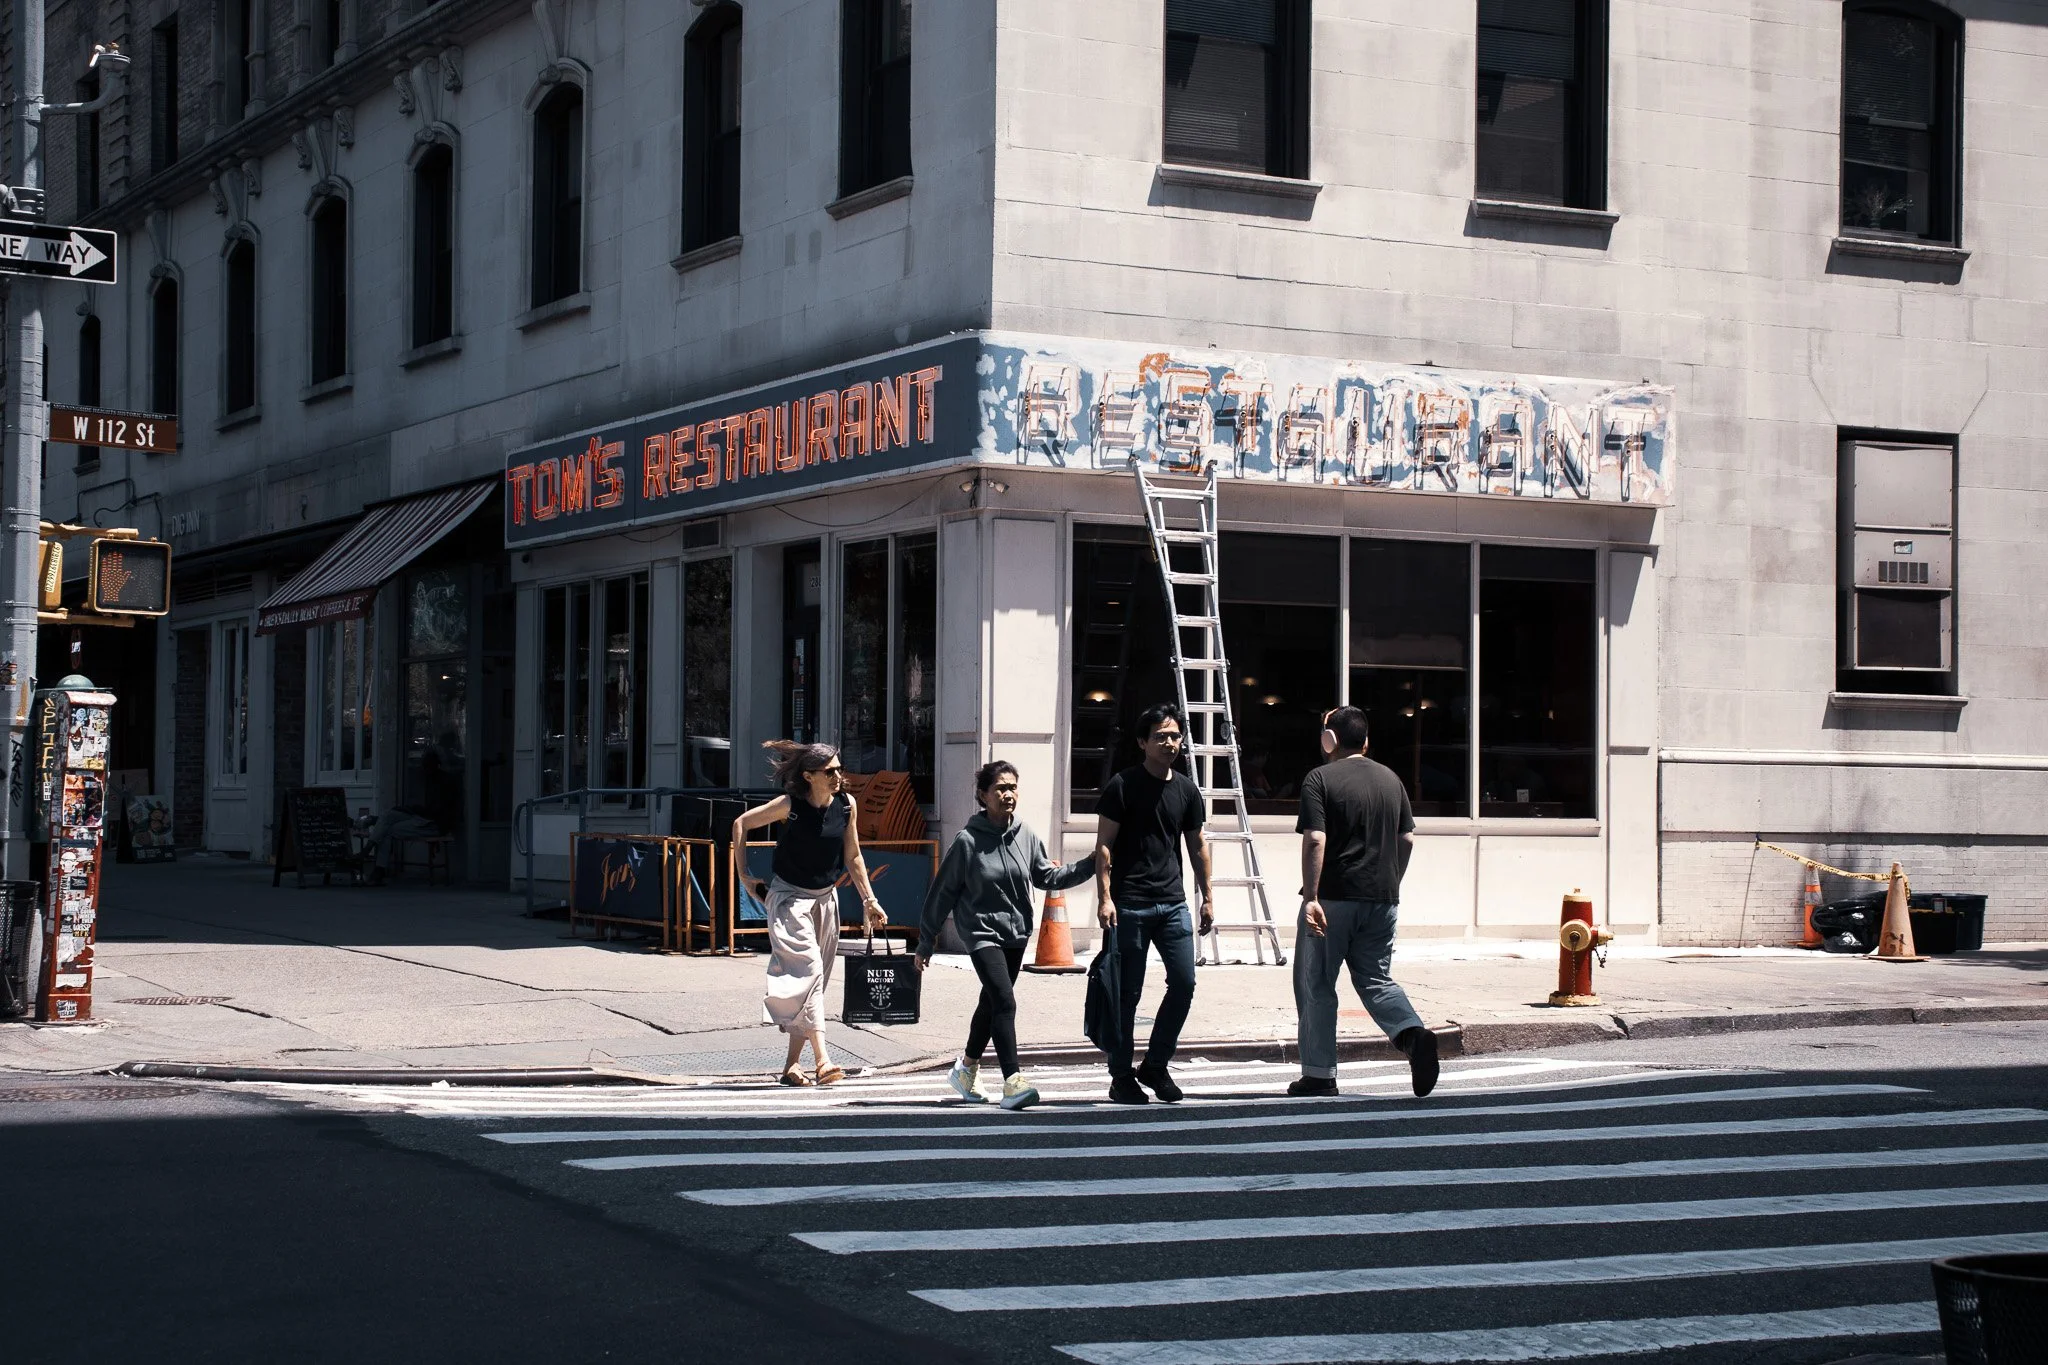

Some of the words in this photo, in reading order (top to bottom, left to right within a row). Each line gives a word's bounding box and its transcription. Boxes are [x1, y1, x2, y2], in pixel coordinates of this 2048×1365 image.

[0, 237, 22, 258] NE
[44, 242, 91, 264] WAY
[73, 415, 88, 440] W
[97, 418, 126, 444] 112
[135, 422, 155, 447] St
[508, 435, 625, 526] TOM'S
[643, 364, 943, 500] RESTAURANT
[1018, 359, 1656, 502] RESTAURANT
[867, 969, 894, 978] NUTS
